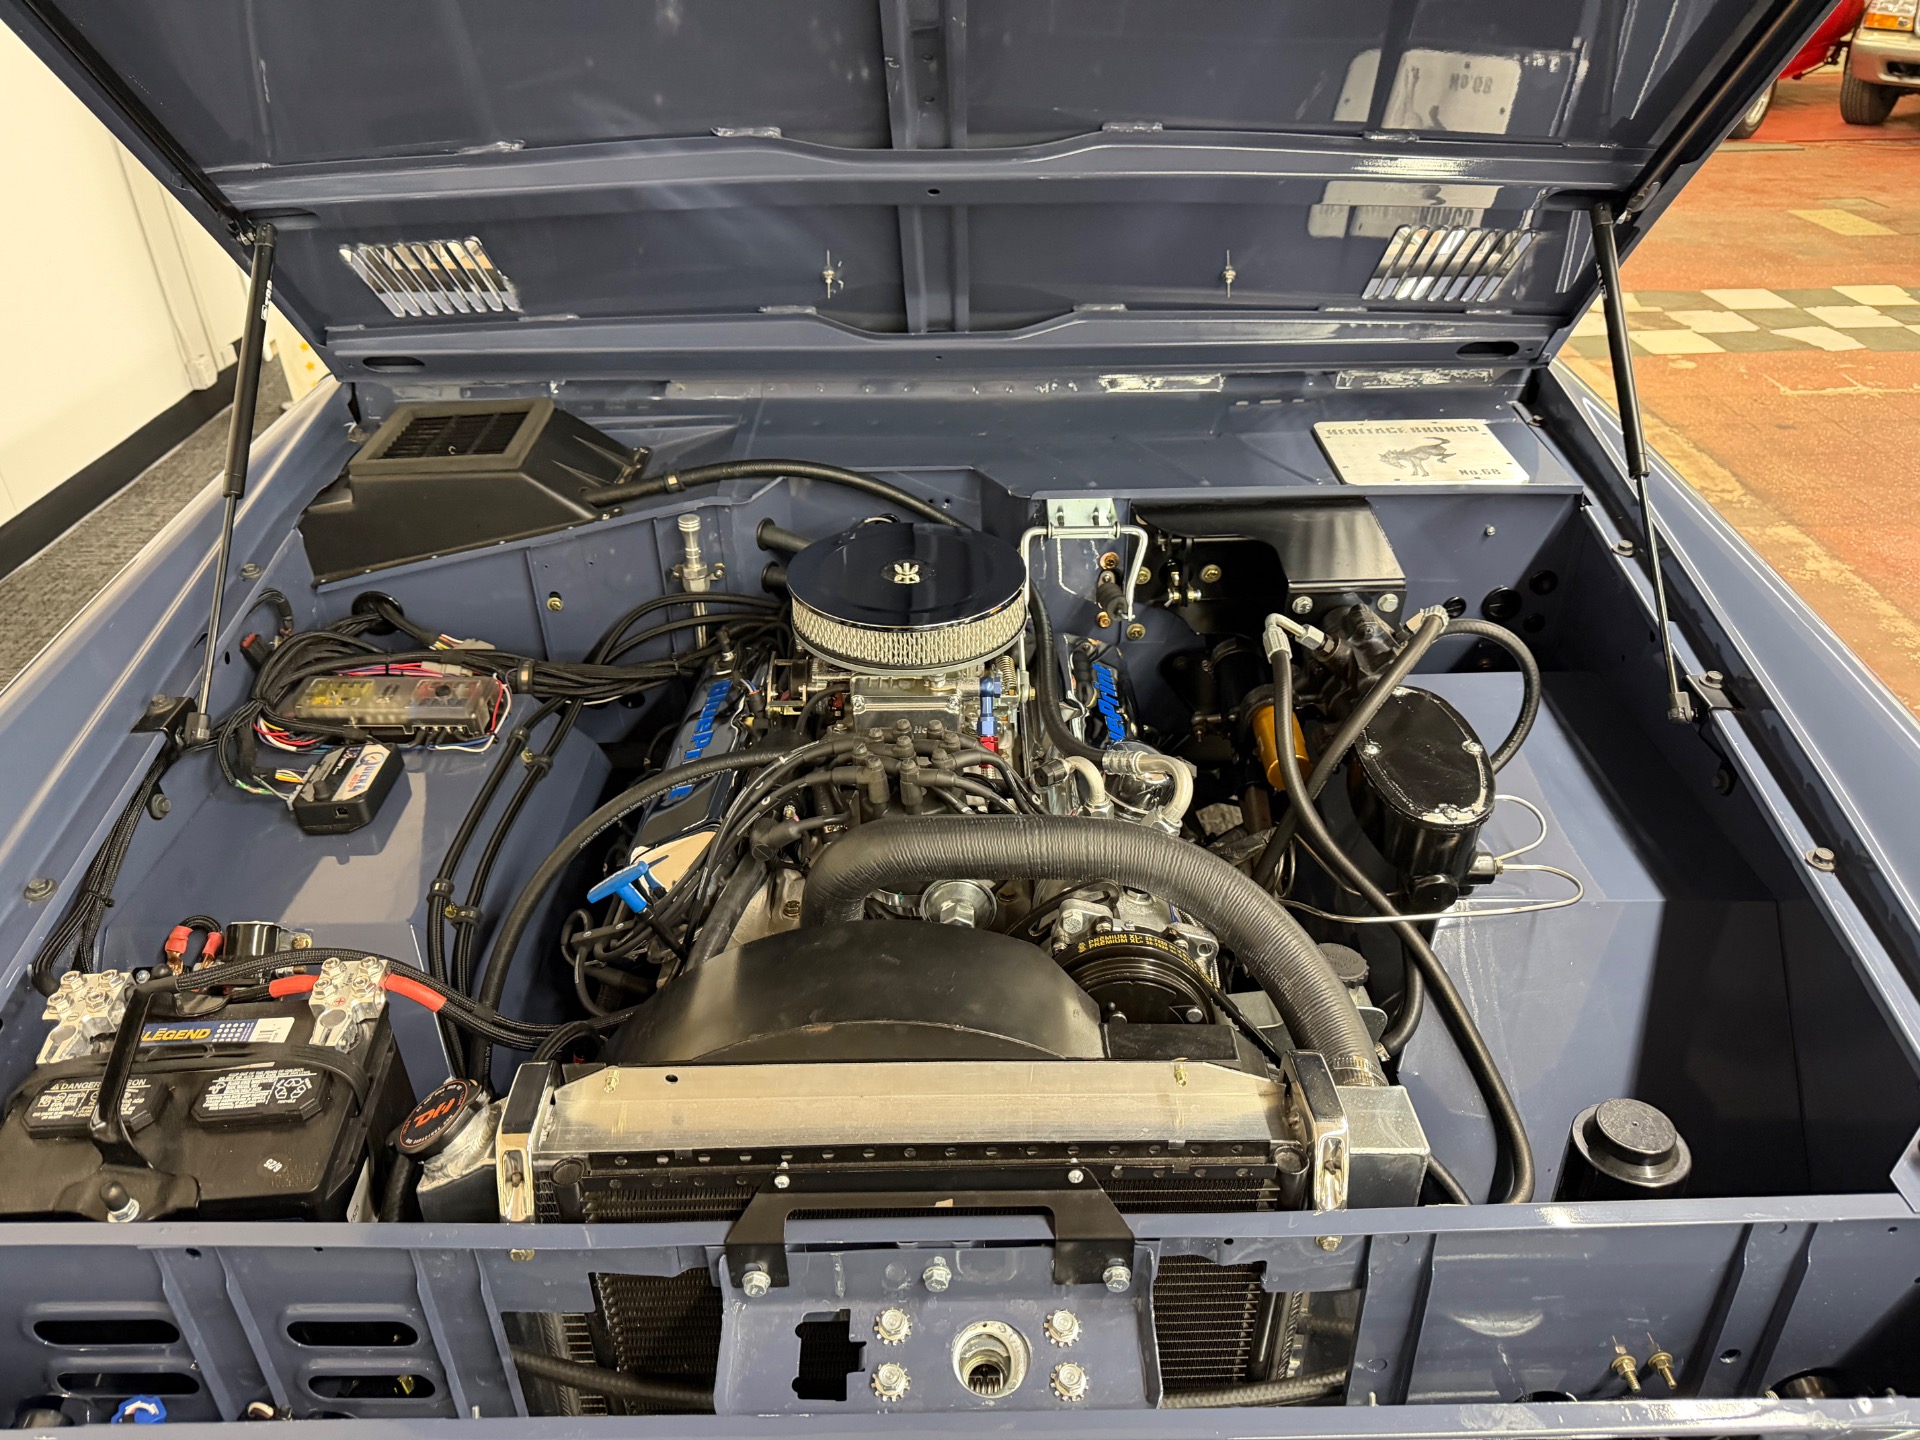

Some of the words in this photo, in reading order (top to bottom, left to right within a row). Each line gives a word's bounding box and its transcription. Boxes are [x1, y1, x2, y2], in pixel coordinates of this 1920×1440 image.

[1325, 427, 1407, 436] HERITAGE
[1411, 425, 1480, 434] BRONCO
[142, 1028, 212, 1042] LEGEND
[60, 1081, 101, 1090] DANGER
